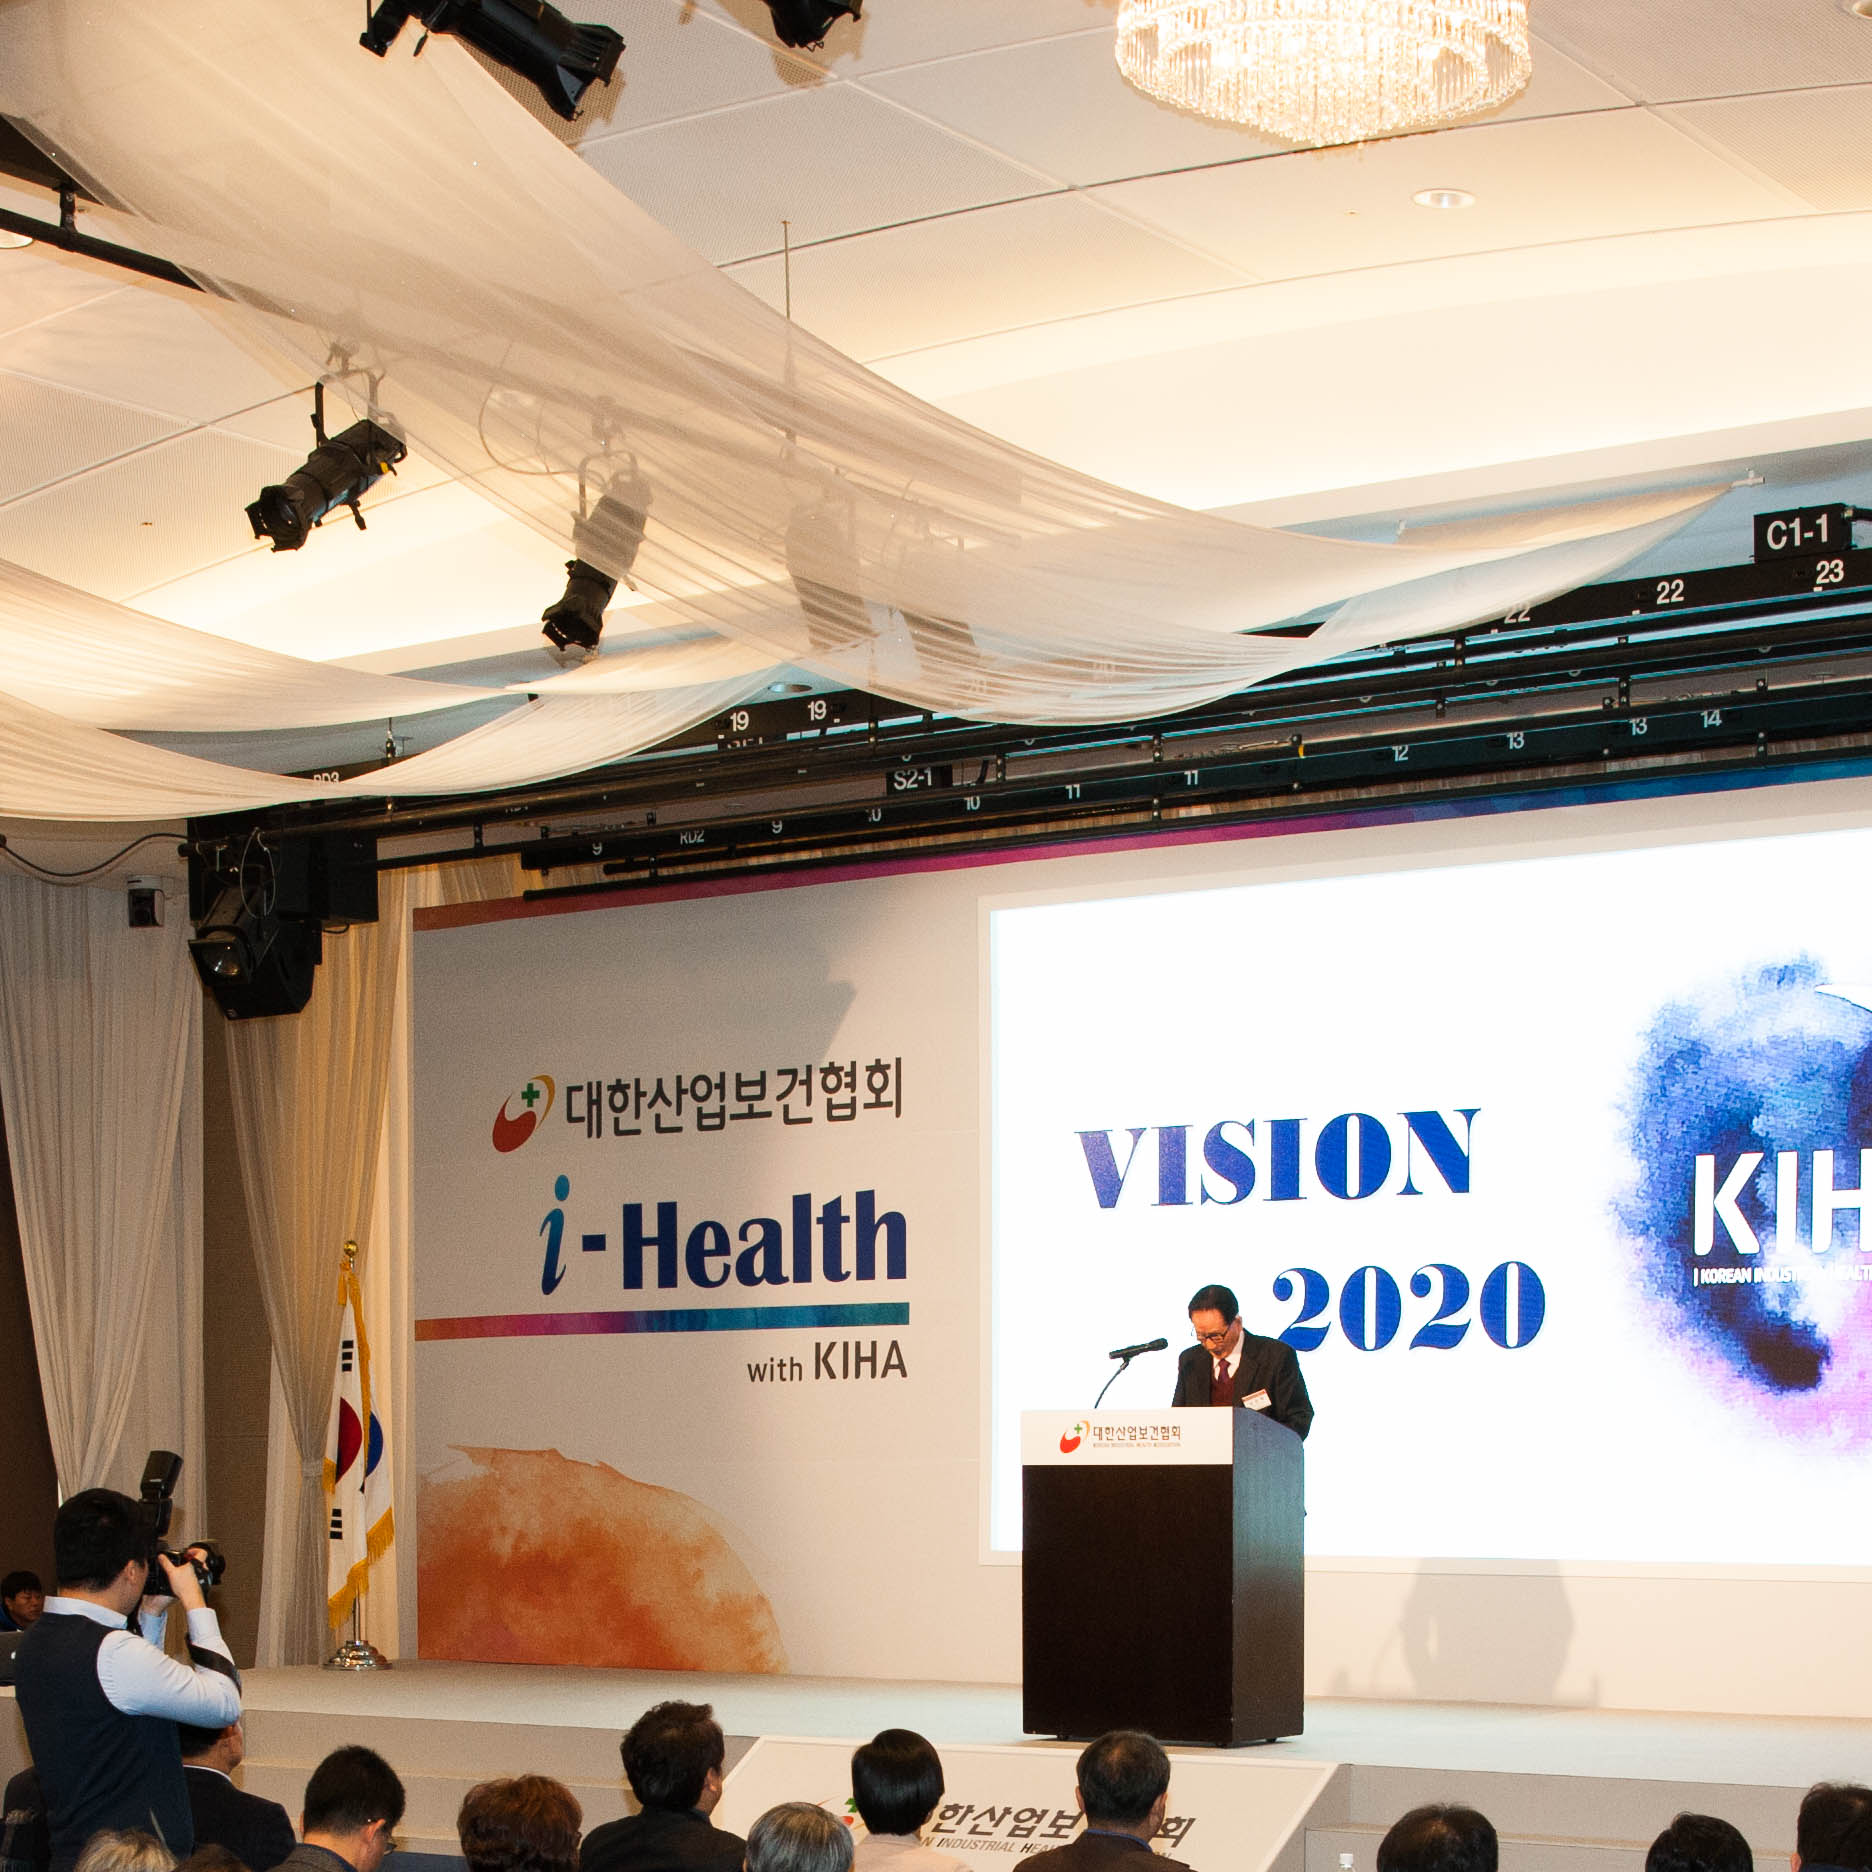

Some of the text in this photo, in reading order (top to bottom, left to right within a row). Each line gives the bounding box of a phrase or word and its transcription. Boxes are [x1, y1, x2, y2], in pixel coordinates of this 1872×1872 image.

[1766, 513, 1829, 551] C1-1
[1815, 559, 1845, 585] 23
[1655, 579, 1686, 605] 22
[729, 711, 750, 732] 19
[808, 700, 827, 721] 19
[1700, 709, 1723, 728] 14
[1629, 717, 1648, 736] 13
[1506, 731, 1525, 750] 13
[1391, 743, 1410, 762] 12
[893, 766, 933, 791] S2-1
[565, 1056, 904, 1139] 대한산업보건협회
[1073, 1107, 1483, 1209] VISION
[1700, 1267, 1752, 1284] KOREAN
[1271, 1260, 1547, 1352] 2020
[746, 1339, 909, 1383] with KIHA
[936, 1836, 1016, 1853] INDUSTRIAL
